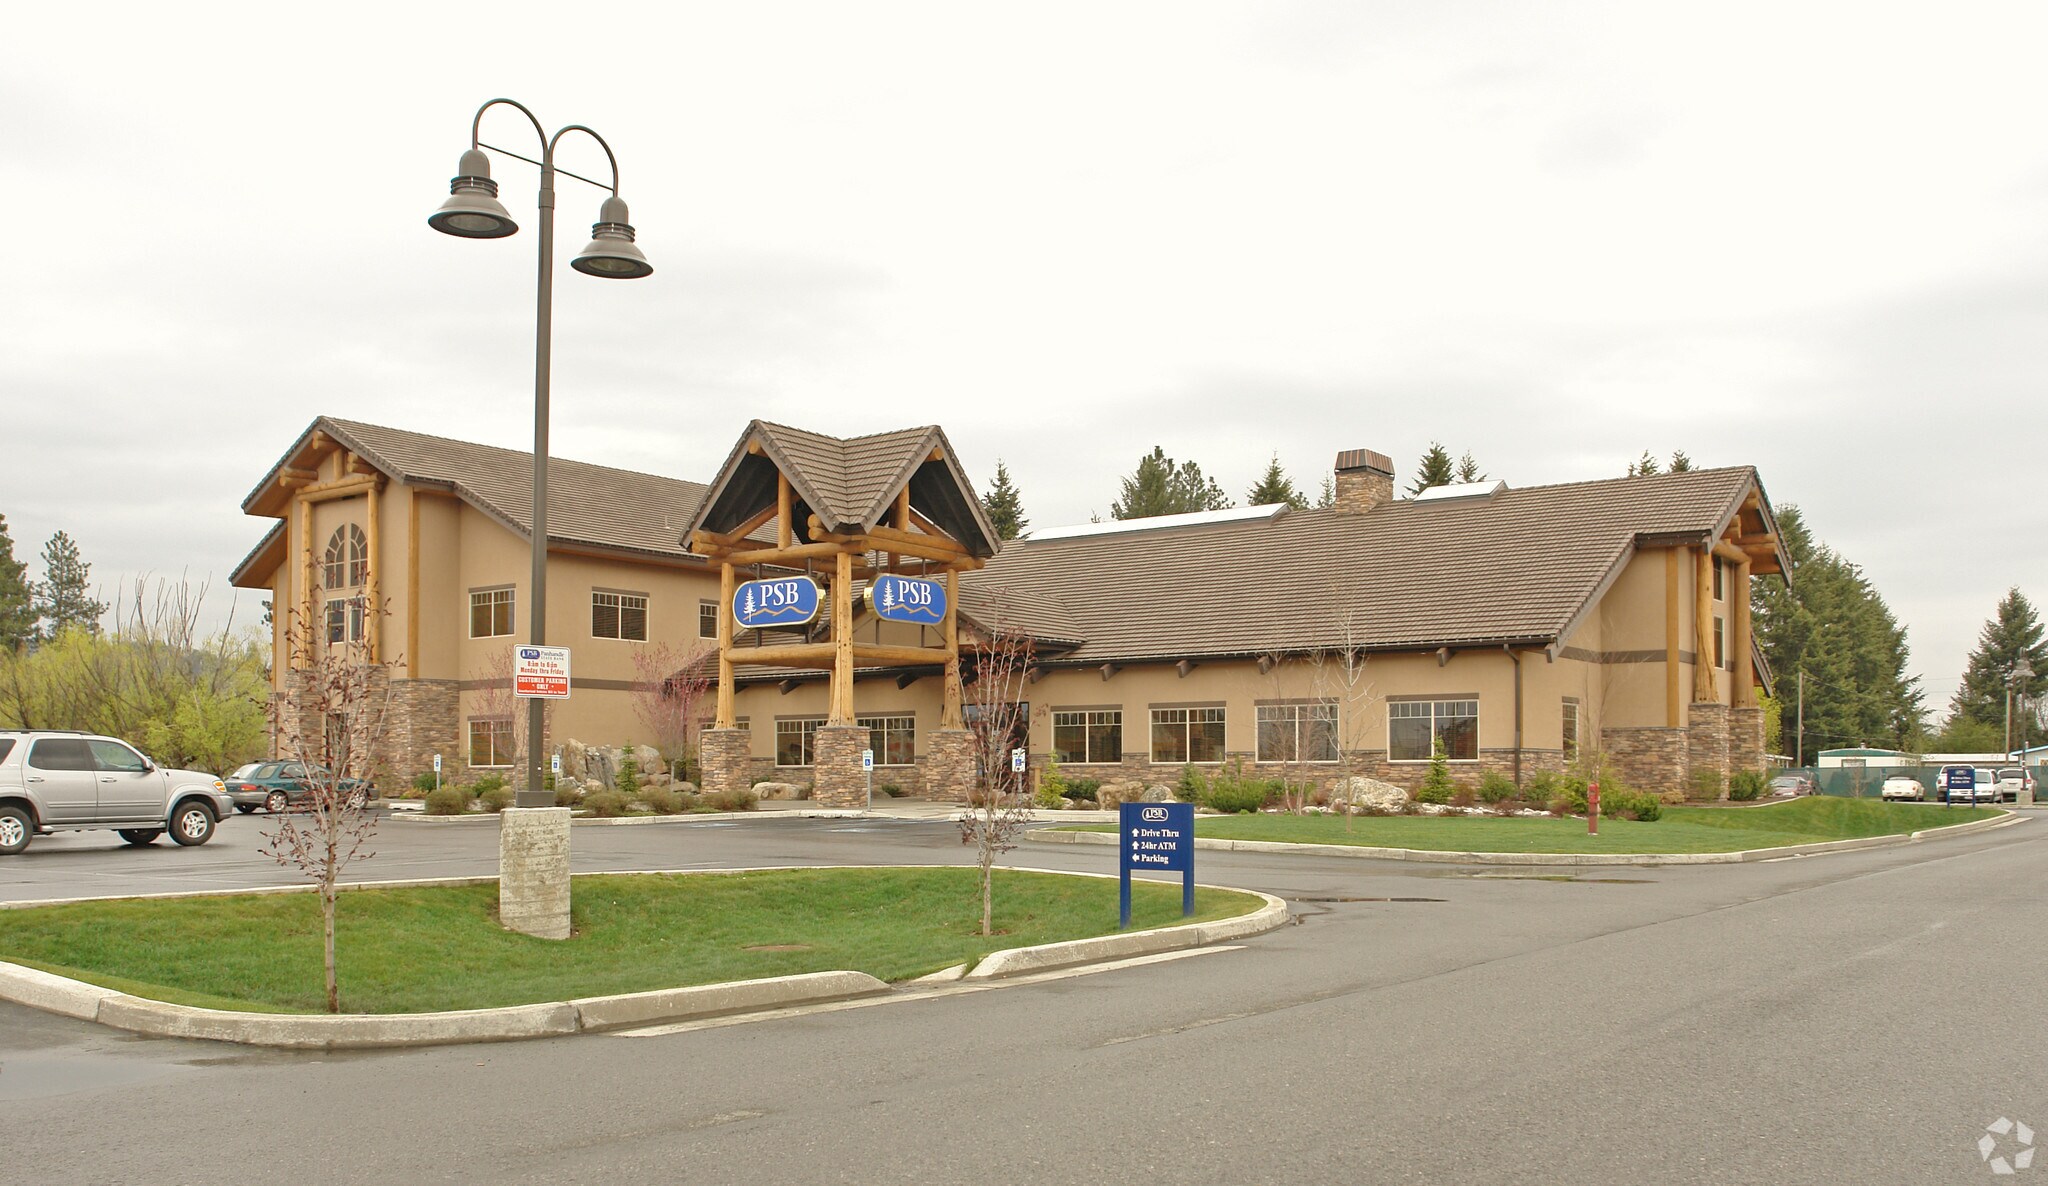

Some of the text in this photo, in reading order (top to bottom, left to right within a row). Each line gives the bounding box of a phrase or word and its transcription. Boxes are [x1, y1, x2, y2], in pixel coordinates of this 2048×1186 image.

[760, 581, 799, 607] PSB
[897, 580, 932, 605] PSB
[520, 666, 538, 674] Monday
[1141, 829, 1180, 837] Drive Thru
[1141, 841, 1176, 850] 24hr ATM
[1141, 853, 1169, 865] Parking
